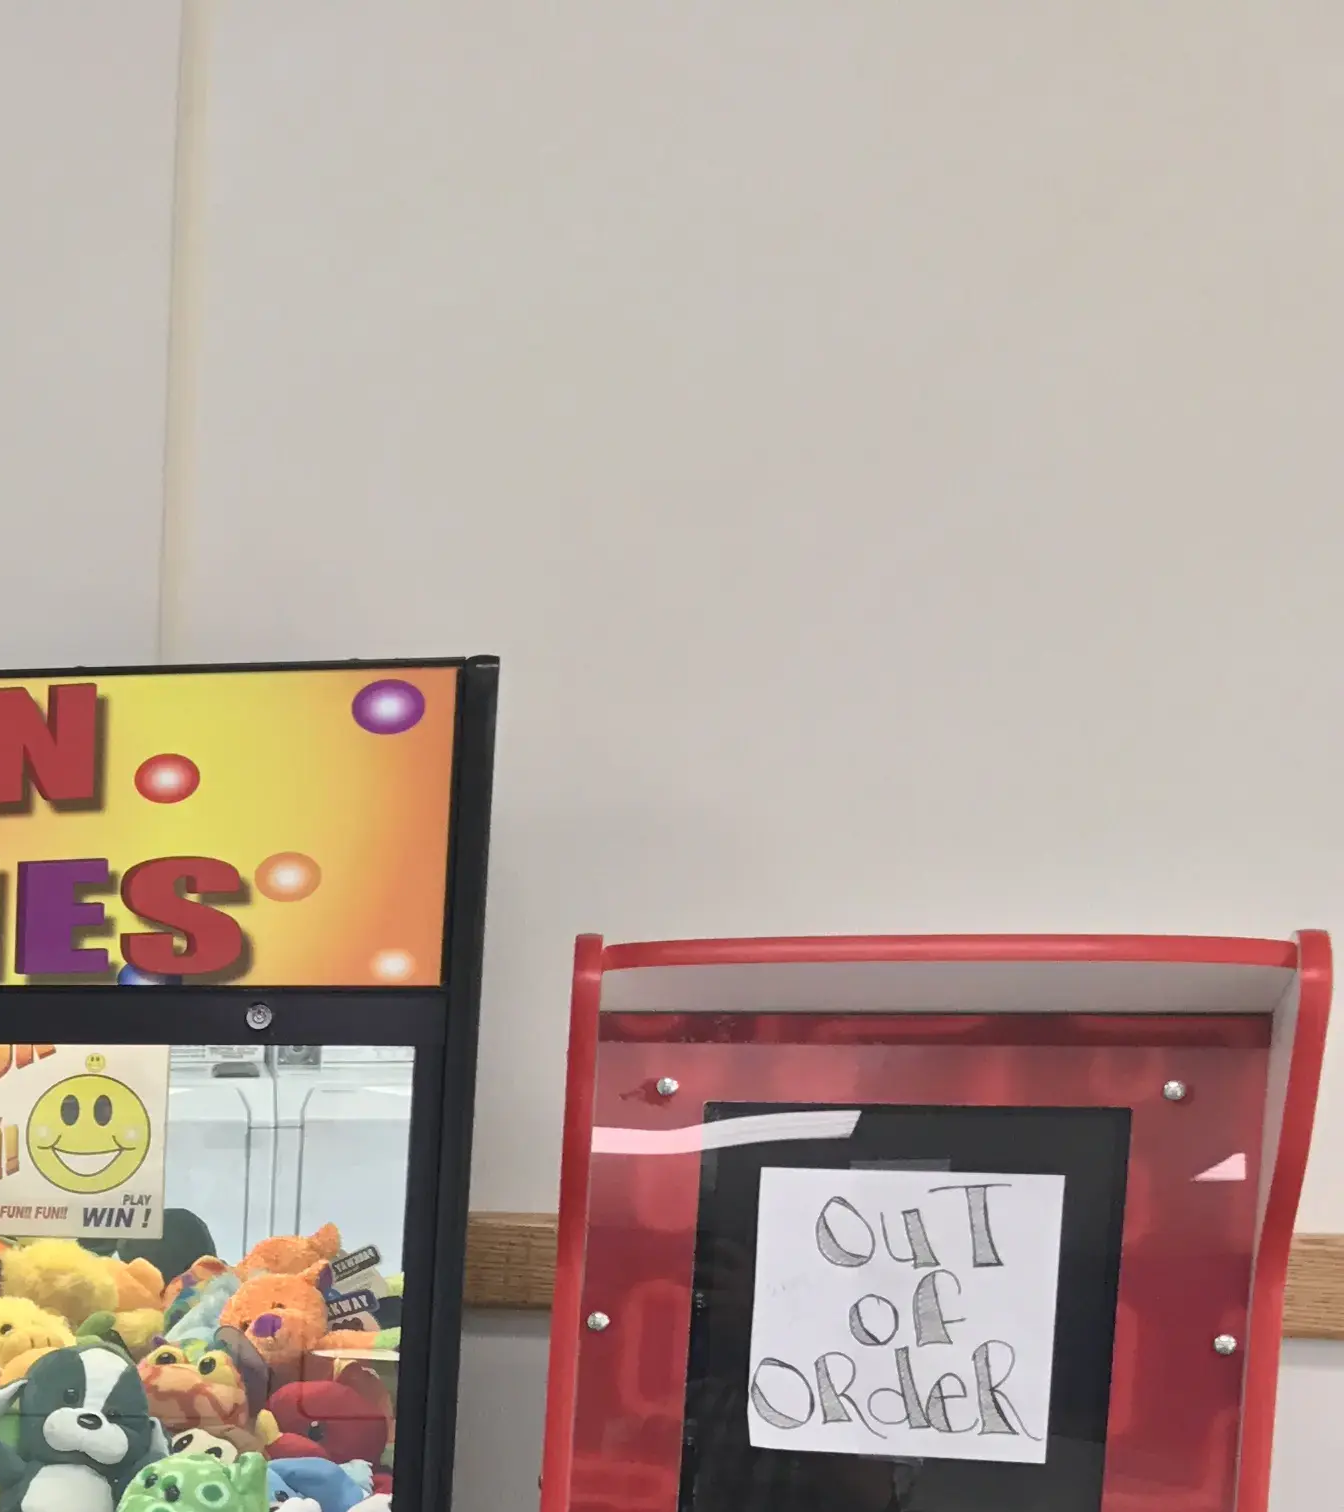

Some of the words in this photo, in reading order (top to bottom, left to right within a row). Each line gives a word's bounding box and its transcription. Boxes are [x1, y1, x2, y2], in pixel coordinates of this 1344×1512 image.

[123, 1194, 151, 1206] PLAY
[34, 1206, 68, 1220] FUN!!
[82, 1207, 135, 1228] WIN
